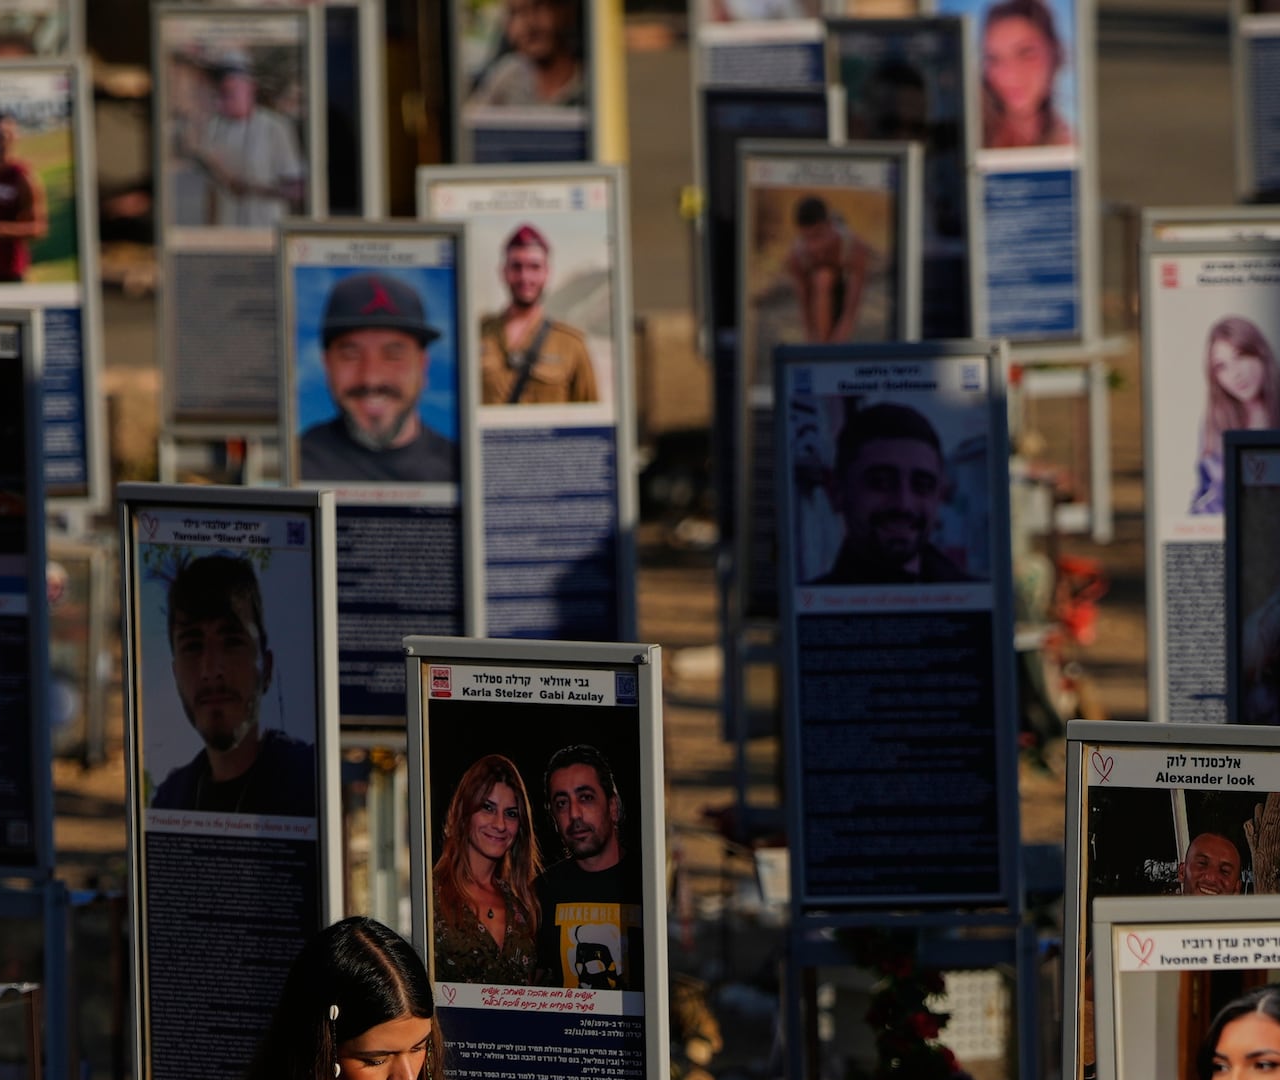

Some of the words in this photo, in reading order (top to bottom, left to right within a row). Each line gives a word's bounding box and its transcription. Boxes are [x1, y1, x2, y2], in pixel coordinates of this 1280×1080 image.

[472, 674, 502, 683] סטלזר
[505, 675, 531, 686] קרלה
[539, 676, 571, 686] אזולאי
[574, 678, 589, 687] גבי
[462, 687, 491, 696] Karla
[494, 688, 533, 698] Stelzer
[539, 690, 564, 699] Gabi
[567, 691, 604, 703] Azulay
[1166, 754, 1186, 768] לוק
[1190, 756, 1240, 768] אלכסנדר
[1155, 772, 1222, 784] Alexander
[1226, 774, 1254, 785] look
[1181, 938, 1212, 948] רוביו
[1217, 938, 1238, 949] עדן
[1159, 955, 1208, 964] Ivonne
[1212, 953, 1248, 963] Eden
